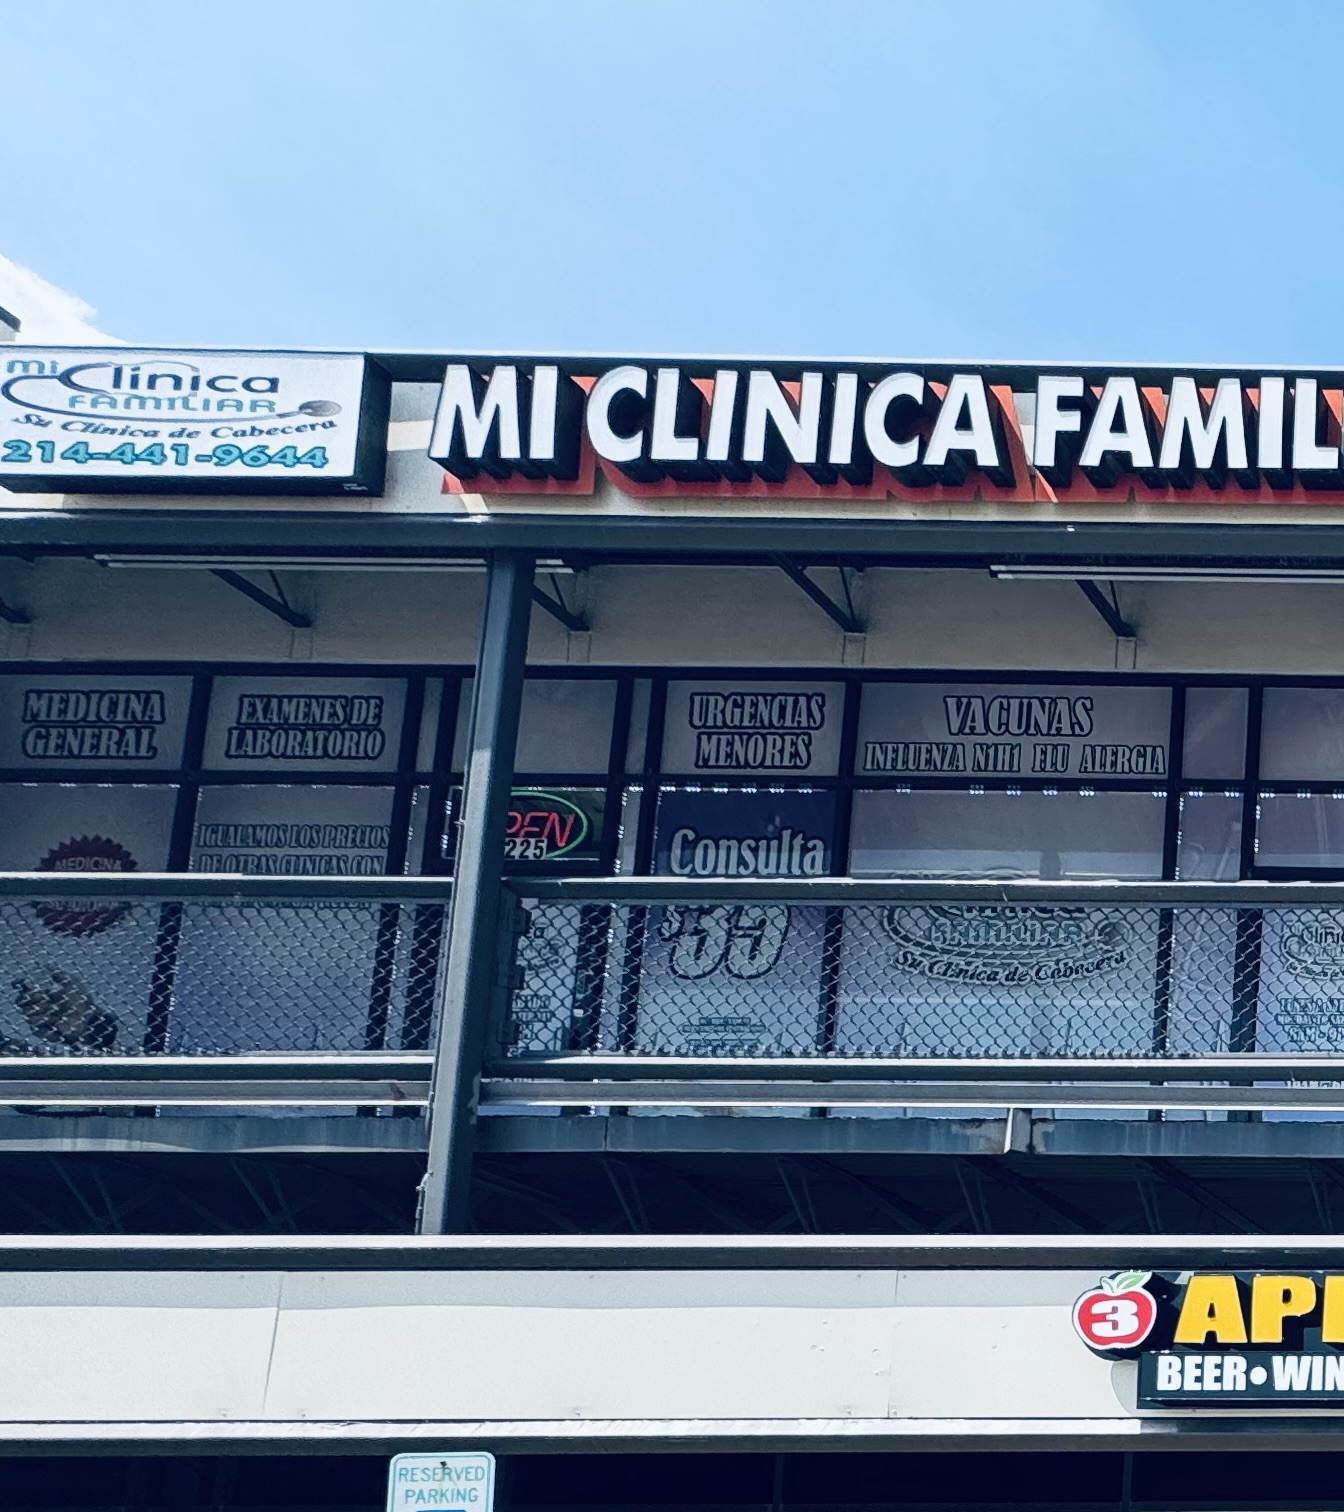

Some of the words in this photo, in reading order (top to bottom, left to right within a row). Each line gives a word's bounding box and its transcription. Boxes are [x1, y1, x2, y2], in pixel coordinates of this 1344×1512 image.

[68, 394, 277, 413] FAMILIAR
[428, 364, 558, 460] MI
[586, 366, 1000, 468] CLINICA
[168, 427, 200, 440] de
[1, 439, 330, 468] 214-441-9644
[22, 691, 165, 724] MEDICINA
[238, 695, 342, 725] EXAMENES
[349, 697, 382, 726] DE
[690, 691, 825, 730] URGENCIAS
[946, 696, 1094, 736] VACUNAS
[22, 726, 157, 760] GENERAL
[225, 728, 385, 760] LABORATORIO
[695, 731, 812, 769] MENORES
[863, 741, 966, 773] INFLUENZA
[1079, 744, 1166, 775] ALERGIA
[199, 824, 288, 848] IGUALAMOS
[289, 824, 322, 848] LOS
[322, 824, 391, 849] PRECIOS
[504, 839, 547, 859] 225
[670, 828, 825, 876] Consulta
[55, 856, 122, 872] MEDICINA
[1090, 1300, 1140, 1335] 3
[1155, 1355, 1246, 1392] BEER
[398, 1465, 486, 1483] RESERVED
[404, 1486, 480, 1505] PARKING
